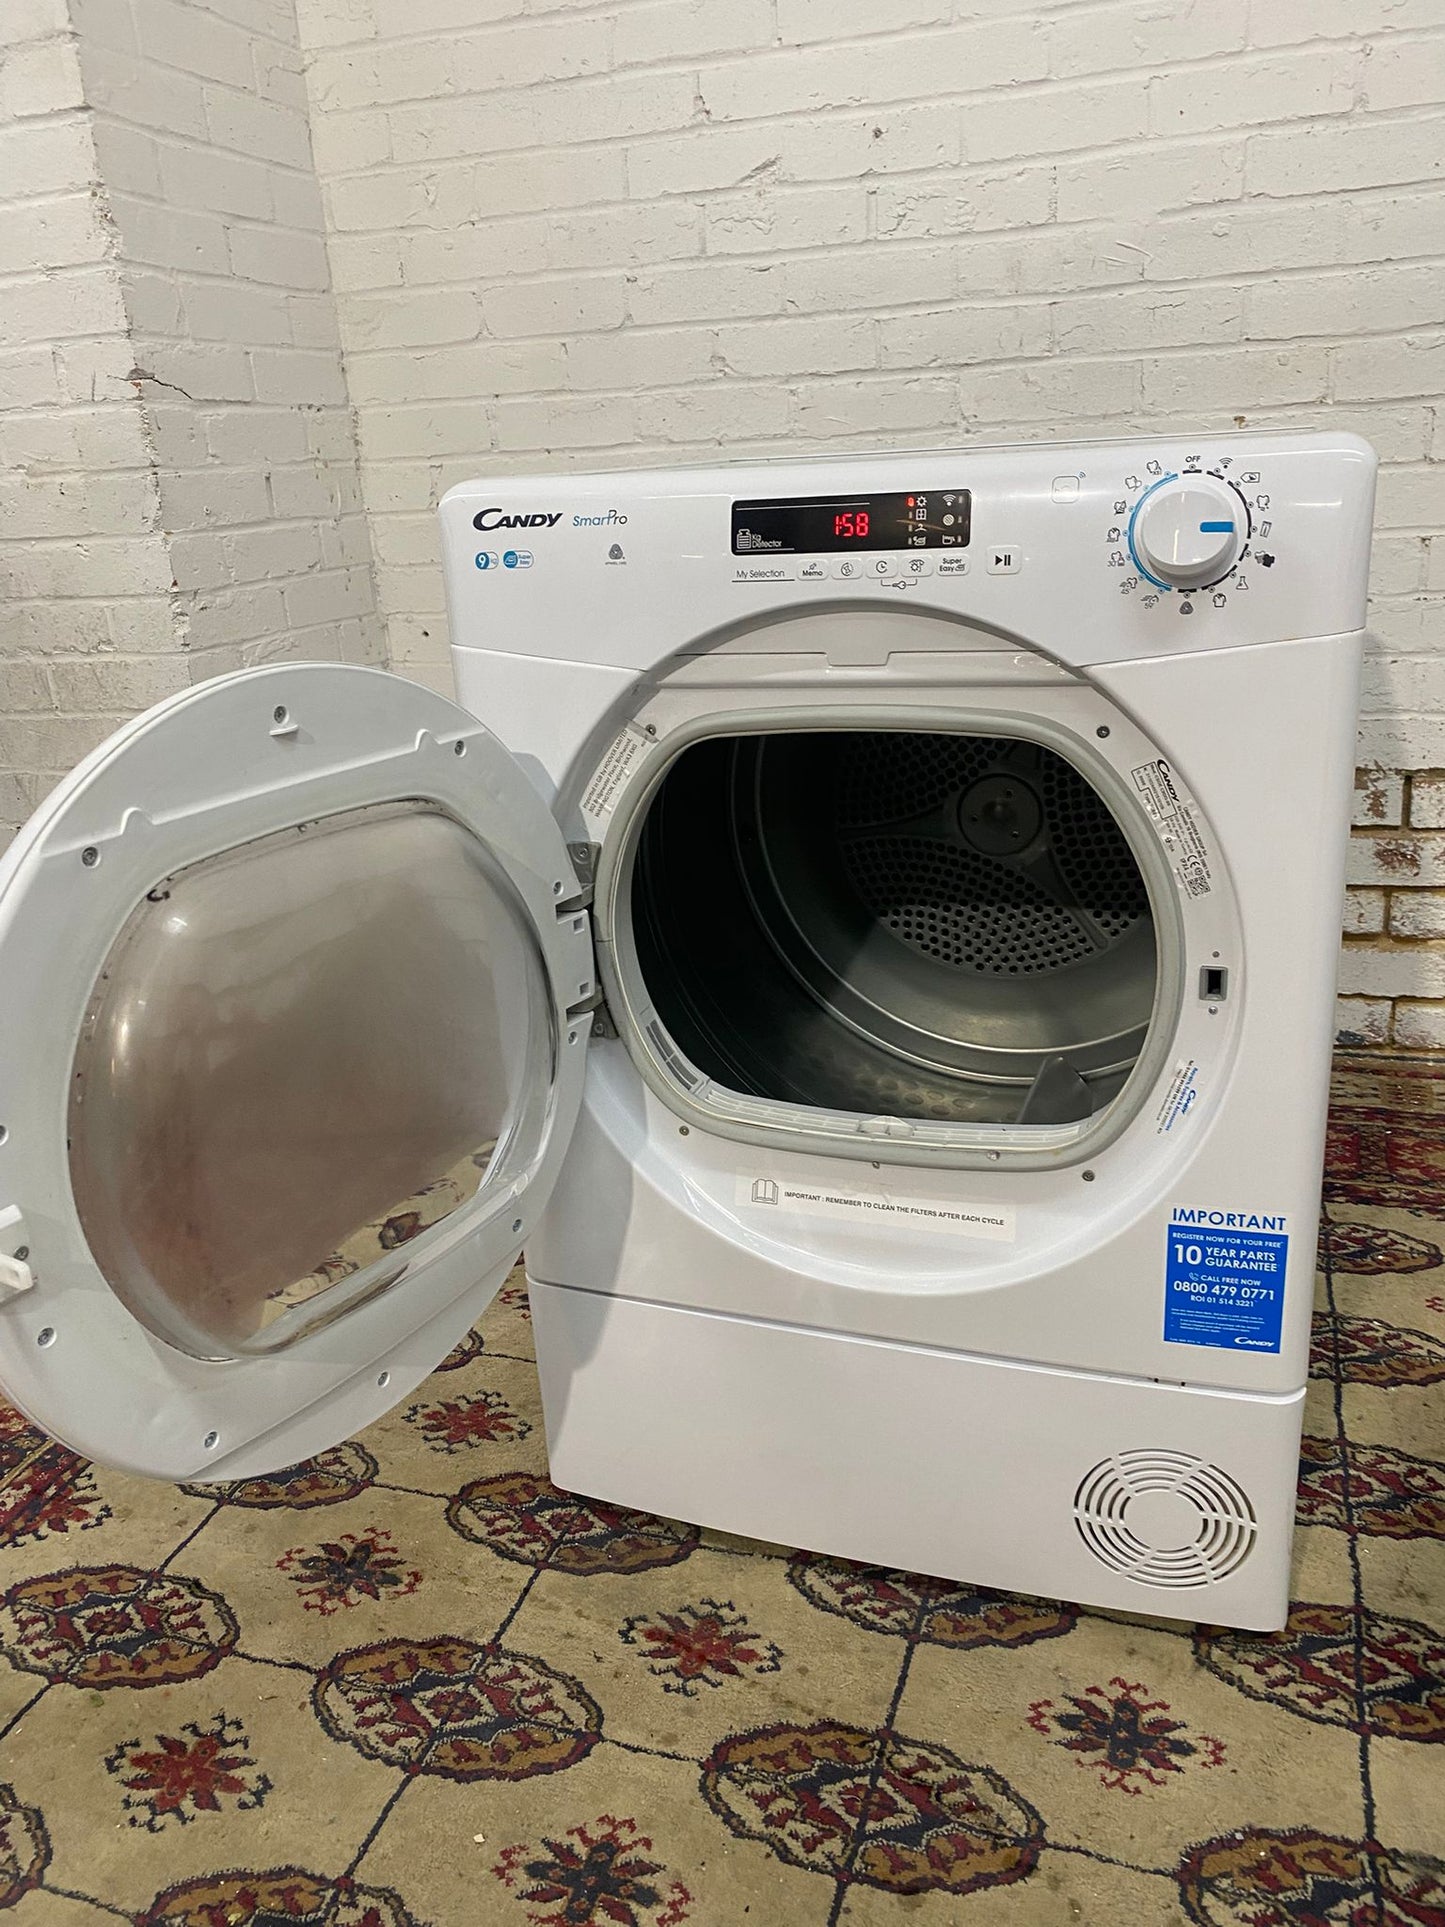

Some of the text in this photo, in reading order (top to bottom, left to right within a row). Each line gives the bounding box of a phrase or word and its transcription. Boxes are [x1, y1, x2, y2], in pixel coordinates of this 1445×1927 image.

[1185, 455, 1201, 463] OFF
[473, 508, 563, 531] CANDY
[752, 540, 782, 548] Detector
[478, 554, 486, 568] 9
[942, 558, 962, 566] Super
[736, 570, 785, 579] My Selection
[802, 569, 823, 577] Memo
[939, 564, 956, 573] Easy
[602, 748, 617, 769] HOOVER
[1157, 759, 1180, 802] CANDY
[785, 1191, 821, 1201] IMPORTANT
[826, 1197, 861, 1207] REMEMBER
[873, 1203, 895, 1211] CLEAN
[911, 1208, 937, 1217] FILTERS
[938, 1212, 960, 1220] AFTER
[1172, 1208, 1286, 1230] IMPORTANT
[1173, 1232, 1204, 1240] REGISTER
[1206, 1235, 1225, 1243] NOW
[1174, 1244, 1202, 1265] 10
[1206, 1247, 1275, 1262] YEAR PARTS
[1205, 1257, 1278, 1272] GUARANTEE
[1174, 1281, 1274, 1300] 0800 479 0771
[1234, 1336, 1275, 1347] CANDY
